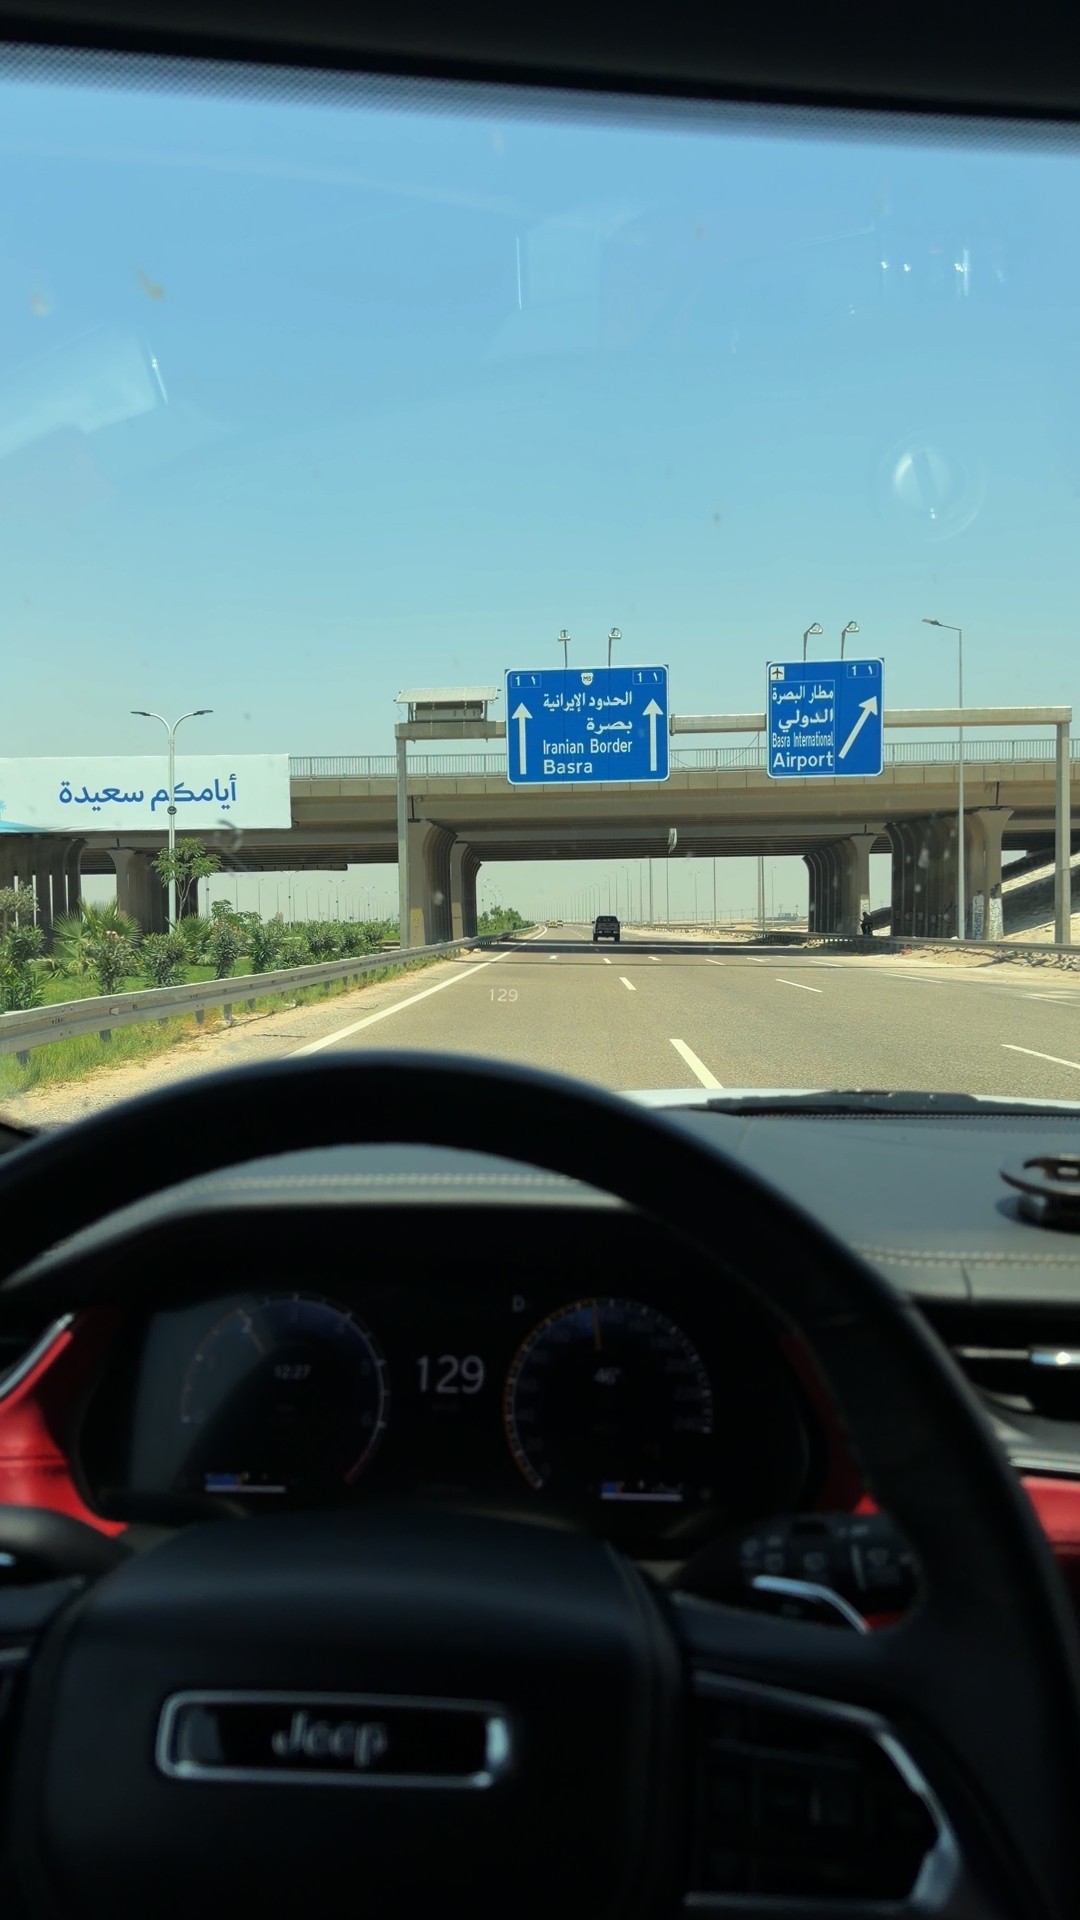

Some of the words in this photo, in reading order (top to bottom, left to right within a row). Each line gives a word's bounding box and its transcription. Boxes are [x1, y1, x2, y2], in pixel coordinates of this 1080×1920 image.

[637, 672, 643, 682] 1
[851, 666, 857, 676] 1
[515, 676, 520, 686] 1
[543, 692, 585, 712] الإيرانية
[589, 691, 632, 711] الحدود
[772, 685, 805, 704] البصرة
[808, 685, 834, 703] مطار
[586, 717, 633, 735] بصرة
[778, 708, 834, 733] الدولي
[543, 739, 584, 755] Iranian
[590, 738, 632, 754] Border
[772, 732, 790, 747] Basra
[793, 731, 834, 747] International
[543, 759, 593, 775] Basra
[773, 751, 834, 771] Airport
[59, 781, 144, 811] سعيدة
[151, 773, 237, 811] أيامكم
[489, 988, 518, 1002] 129
[416, 1355, 485, 1395] 129
[272, 1711, 387, 1767] Jeep
